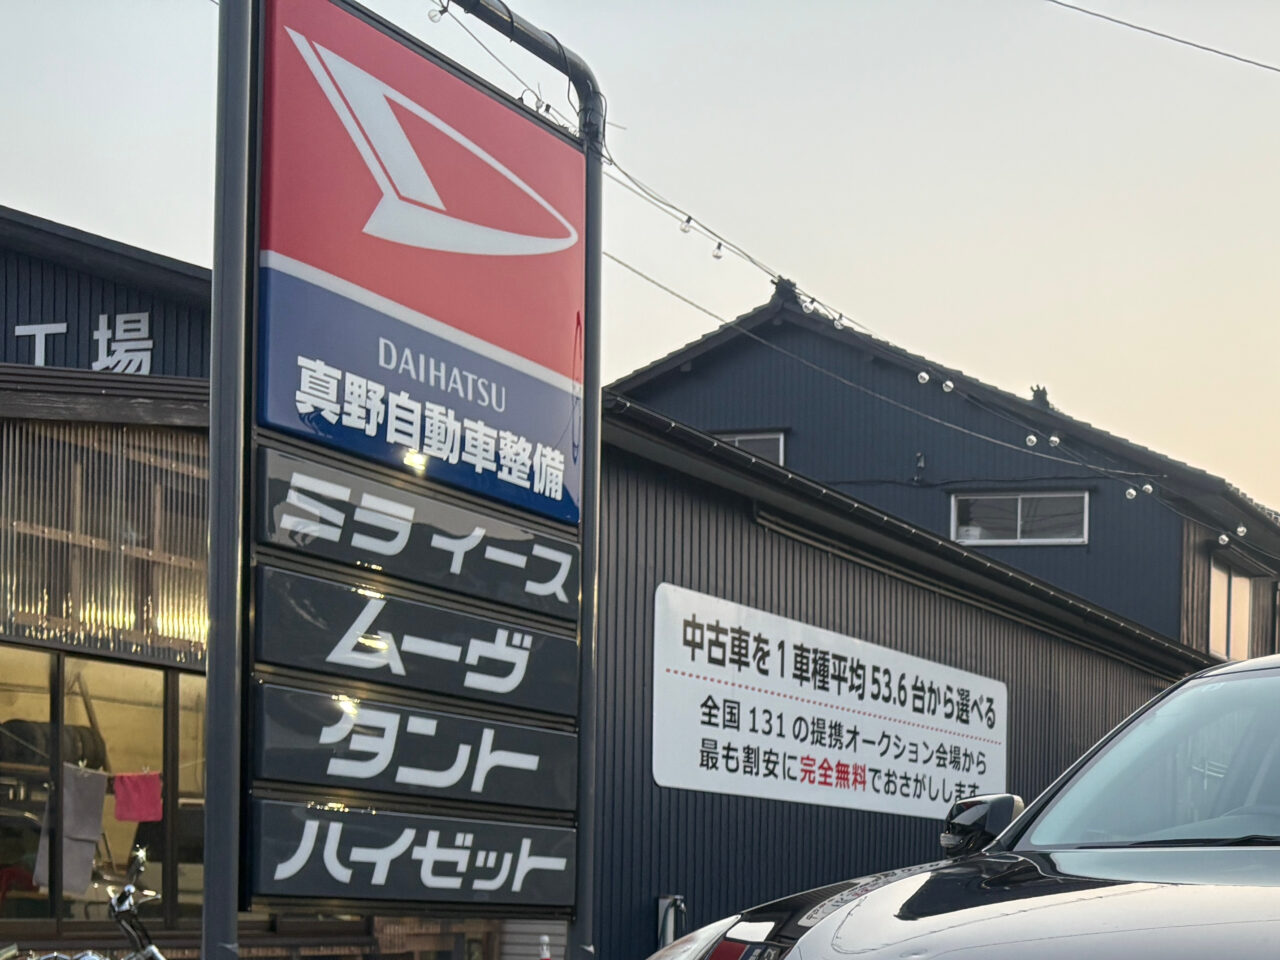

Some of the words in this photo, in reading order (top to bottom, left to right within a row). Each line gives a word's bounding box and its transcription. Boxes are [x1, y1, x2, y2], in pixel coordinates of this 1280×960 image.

[378, 336, 507, 413] DAIHATSU
[295, 355, 566, 500] 真野自動車整備
[325, 599, 533, 694] ムーヴ
[318, 698, 540, 793] タント
[273, 819, 567, 893] ハイゼット
